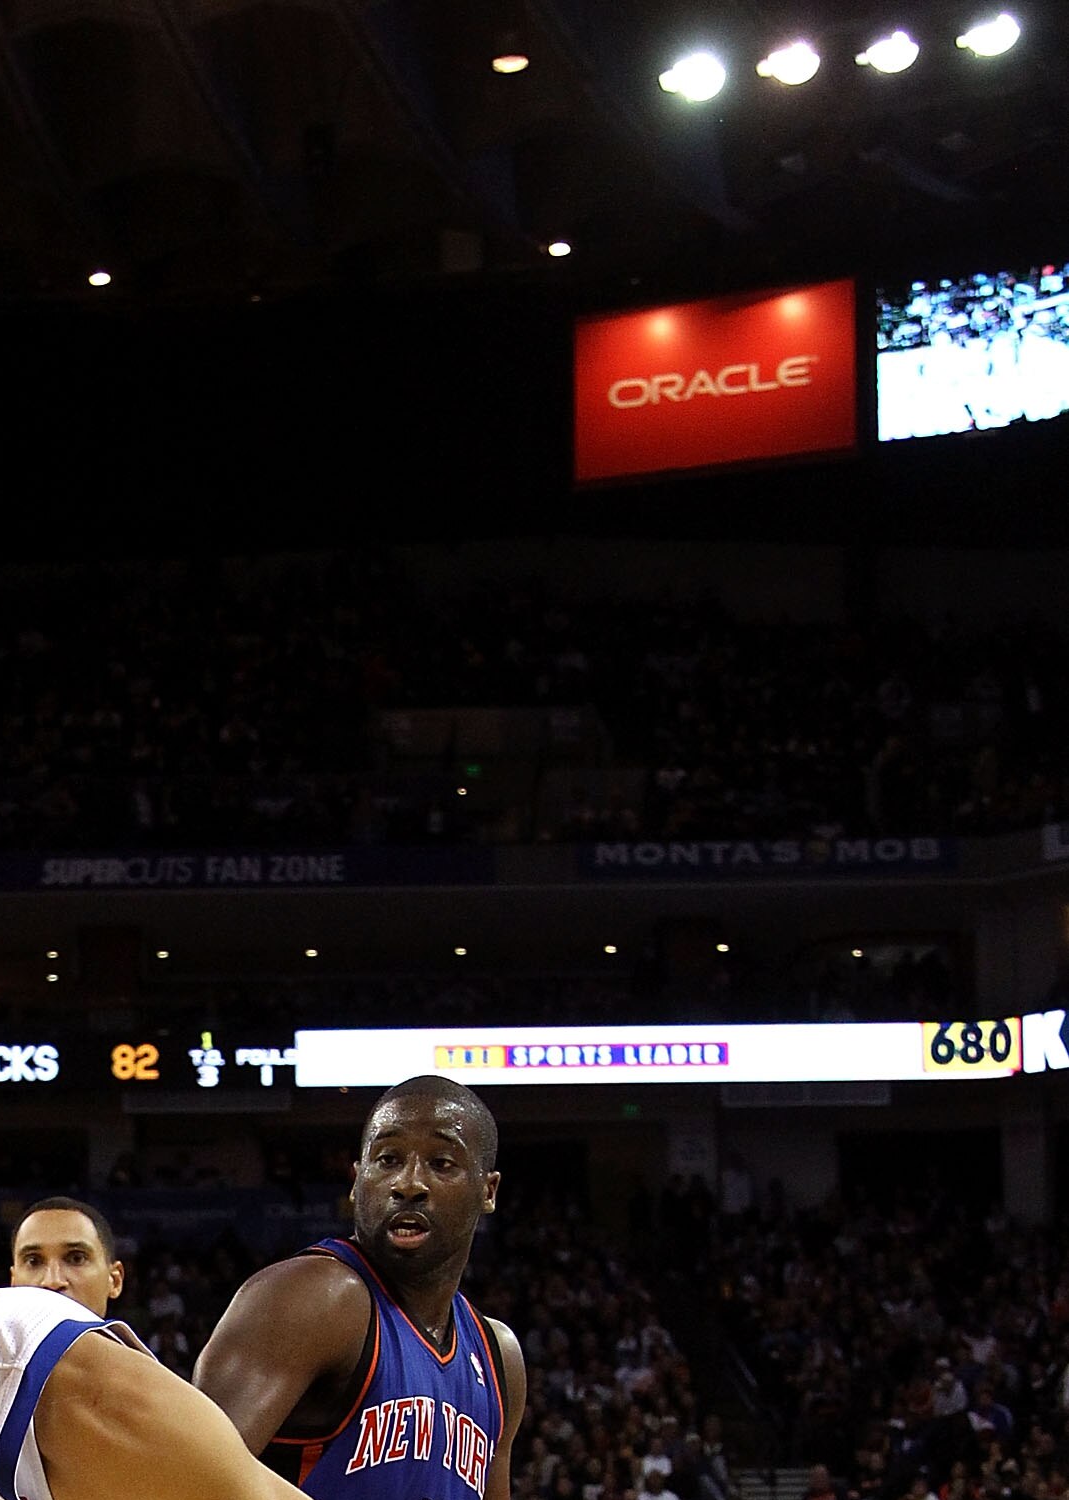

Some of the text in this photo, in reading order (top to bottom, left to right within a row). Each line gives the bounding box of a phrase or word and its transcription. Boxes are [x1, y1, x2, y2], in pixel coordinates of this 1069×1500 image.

[607, 354, 812, 410] ORACLE
[40, 853, 347, 886] SUPERCUTS FAN ZONE
[593, 837, 940, 867] MONTA'S MOB
[512, 1045, 613, 1067] SPORTS
[622, 1044, 721, 1066] LEADER
[929, 1018, 1013, 1065] 680
[110, 1043, 160, 1081] 82
[344, 1395, 495, 1500] NEW YOR
